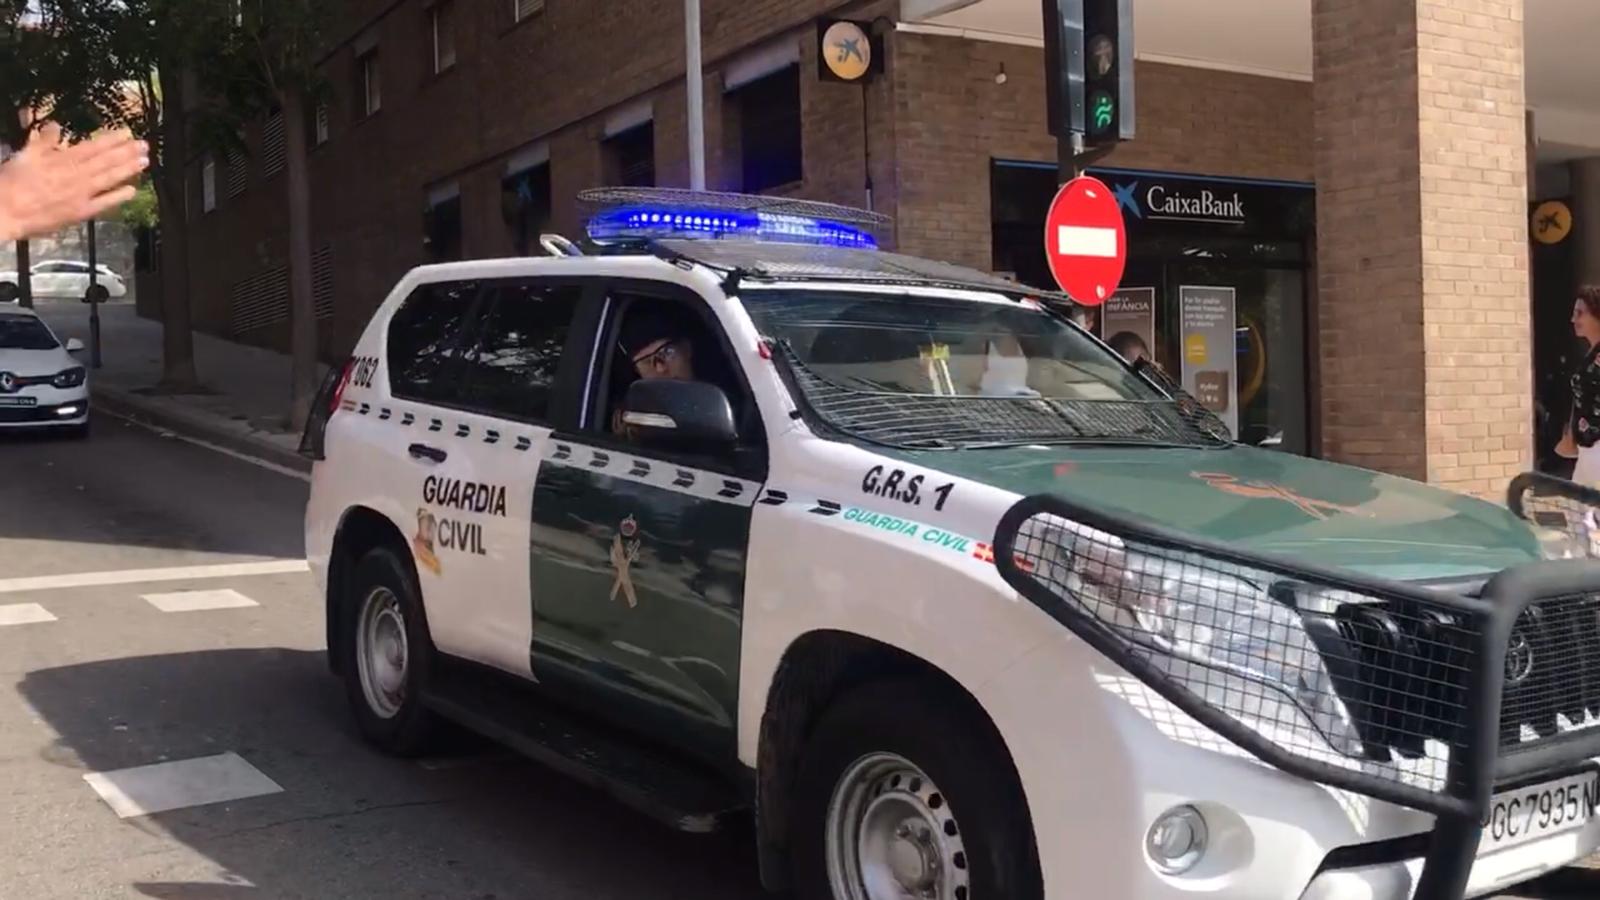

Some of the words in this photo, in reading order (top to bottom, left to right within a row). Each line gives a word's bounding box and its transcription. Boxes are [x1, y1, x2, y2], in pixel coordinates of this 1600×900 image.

[1147, 185, 1245, 217] CaixaBank
[423, 475, 506, 518] GUARDIA
[862, 465, 924, 505] G.R.S.
[934, 483, 955, 512] 1
[438, 518, 487, 555] CIVIL
[843, 507, 919, 537] GUARDIA
[922, 529, 971, 553] CIVIL
[1483, 798, 1521, 842] GC
